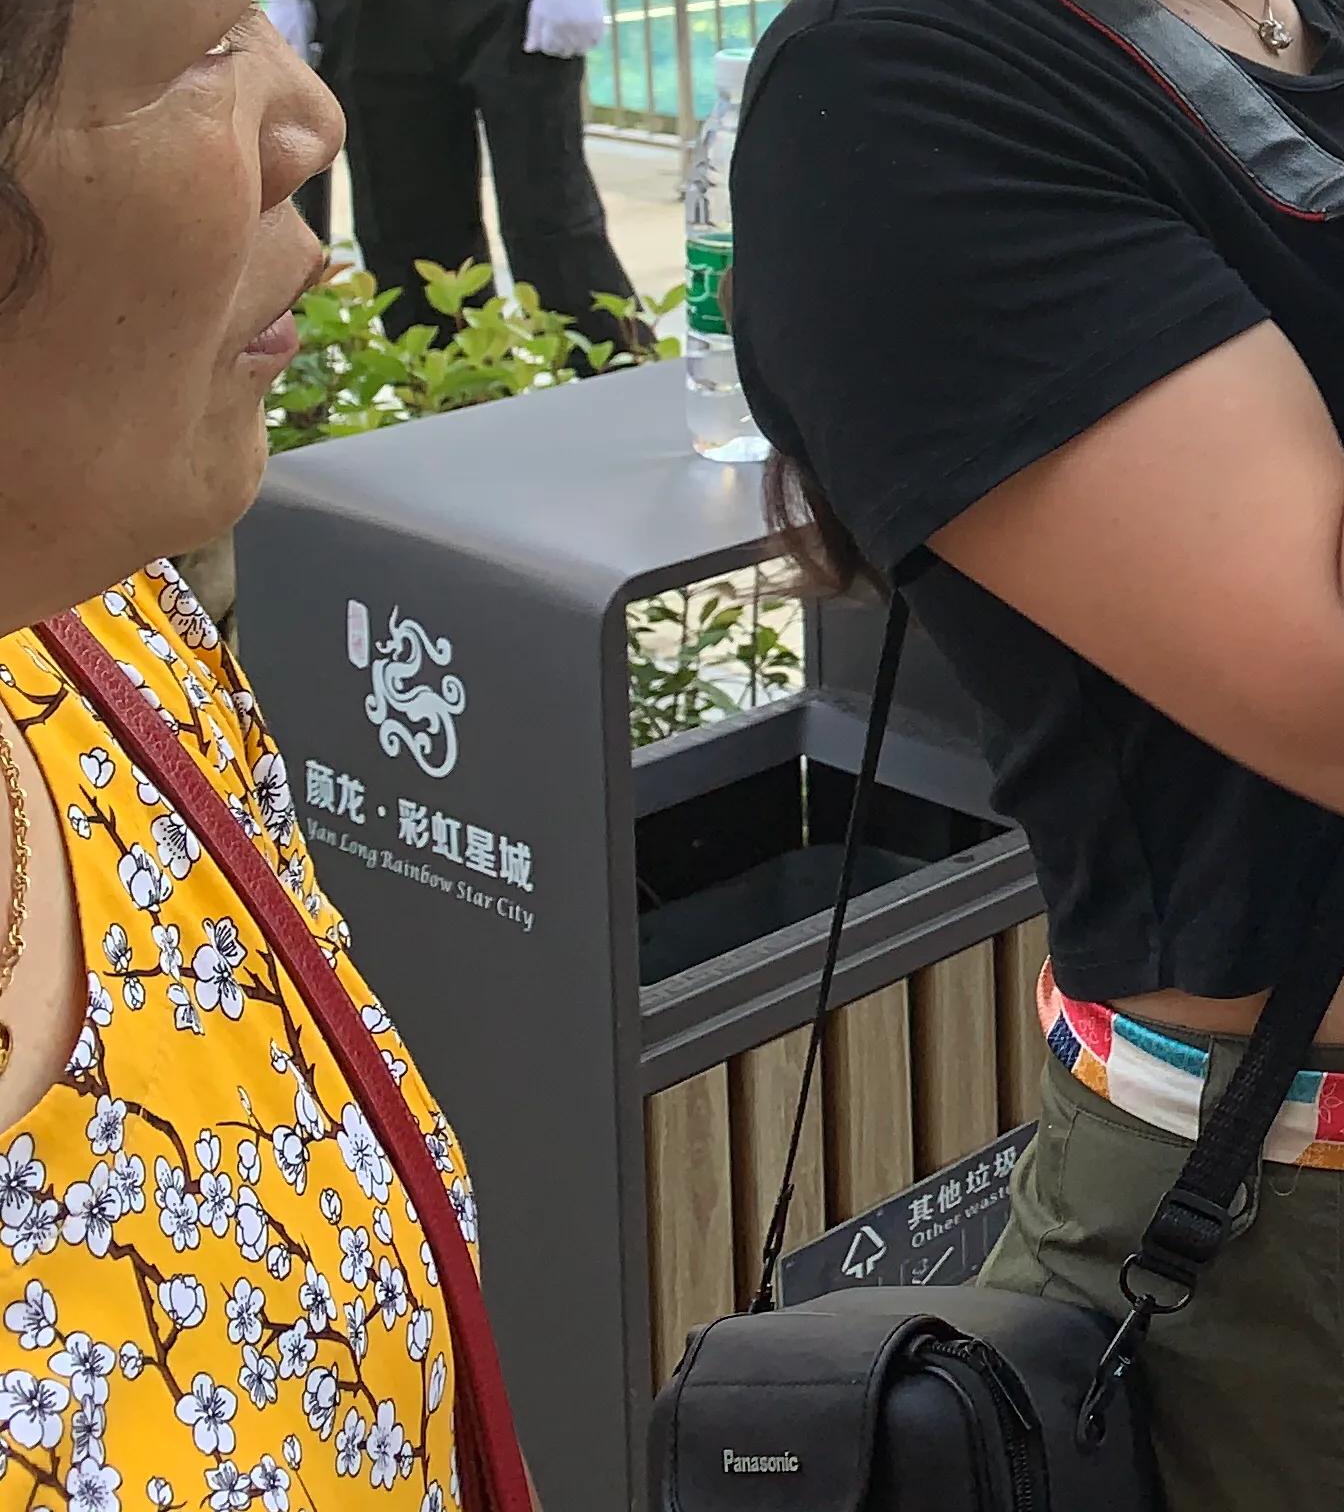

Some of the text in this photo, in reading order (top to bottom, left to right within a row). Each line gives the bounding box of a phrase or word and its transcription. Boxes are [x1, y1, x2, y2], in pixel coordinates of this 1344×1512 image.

[307, 818, 534, 932] Yan Long Rainbow Star City
[908, 1146, 1017, 1230] 其他垃圾
[911, 1214, 962, 1248] Other
[723, 1449, 799, 1473] Panasonic
